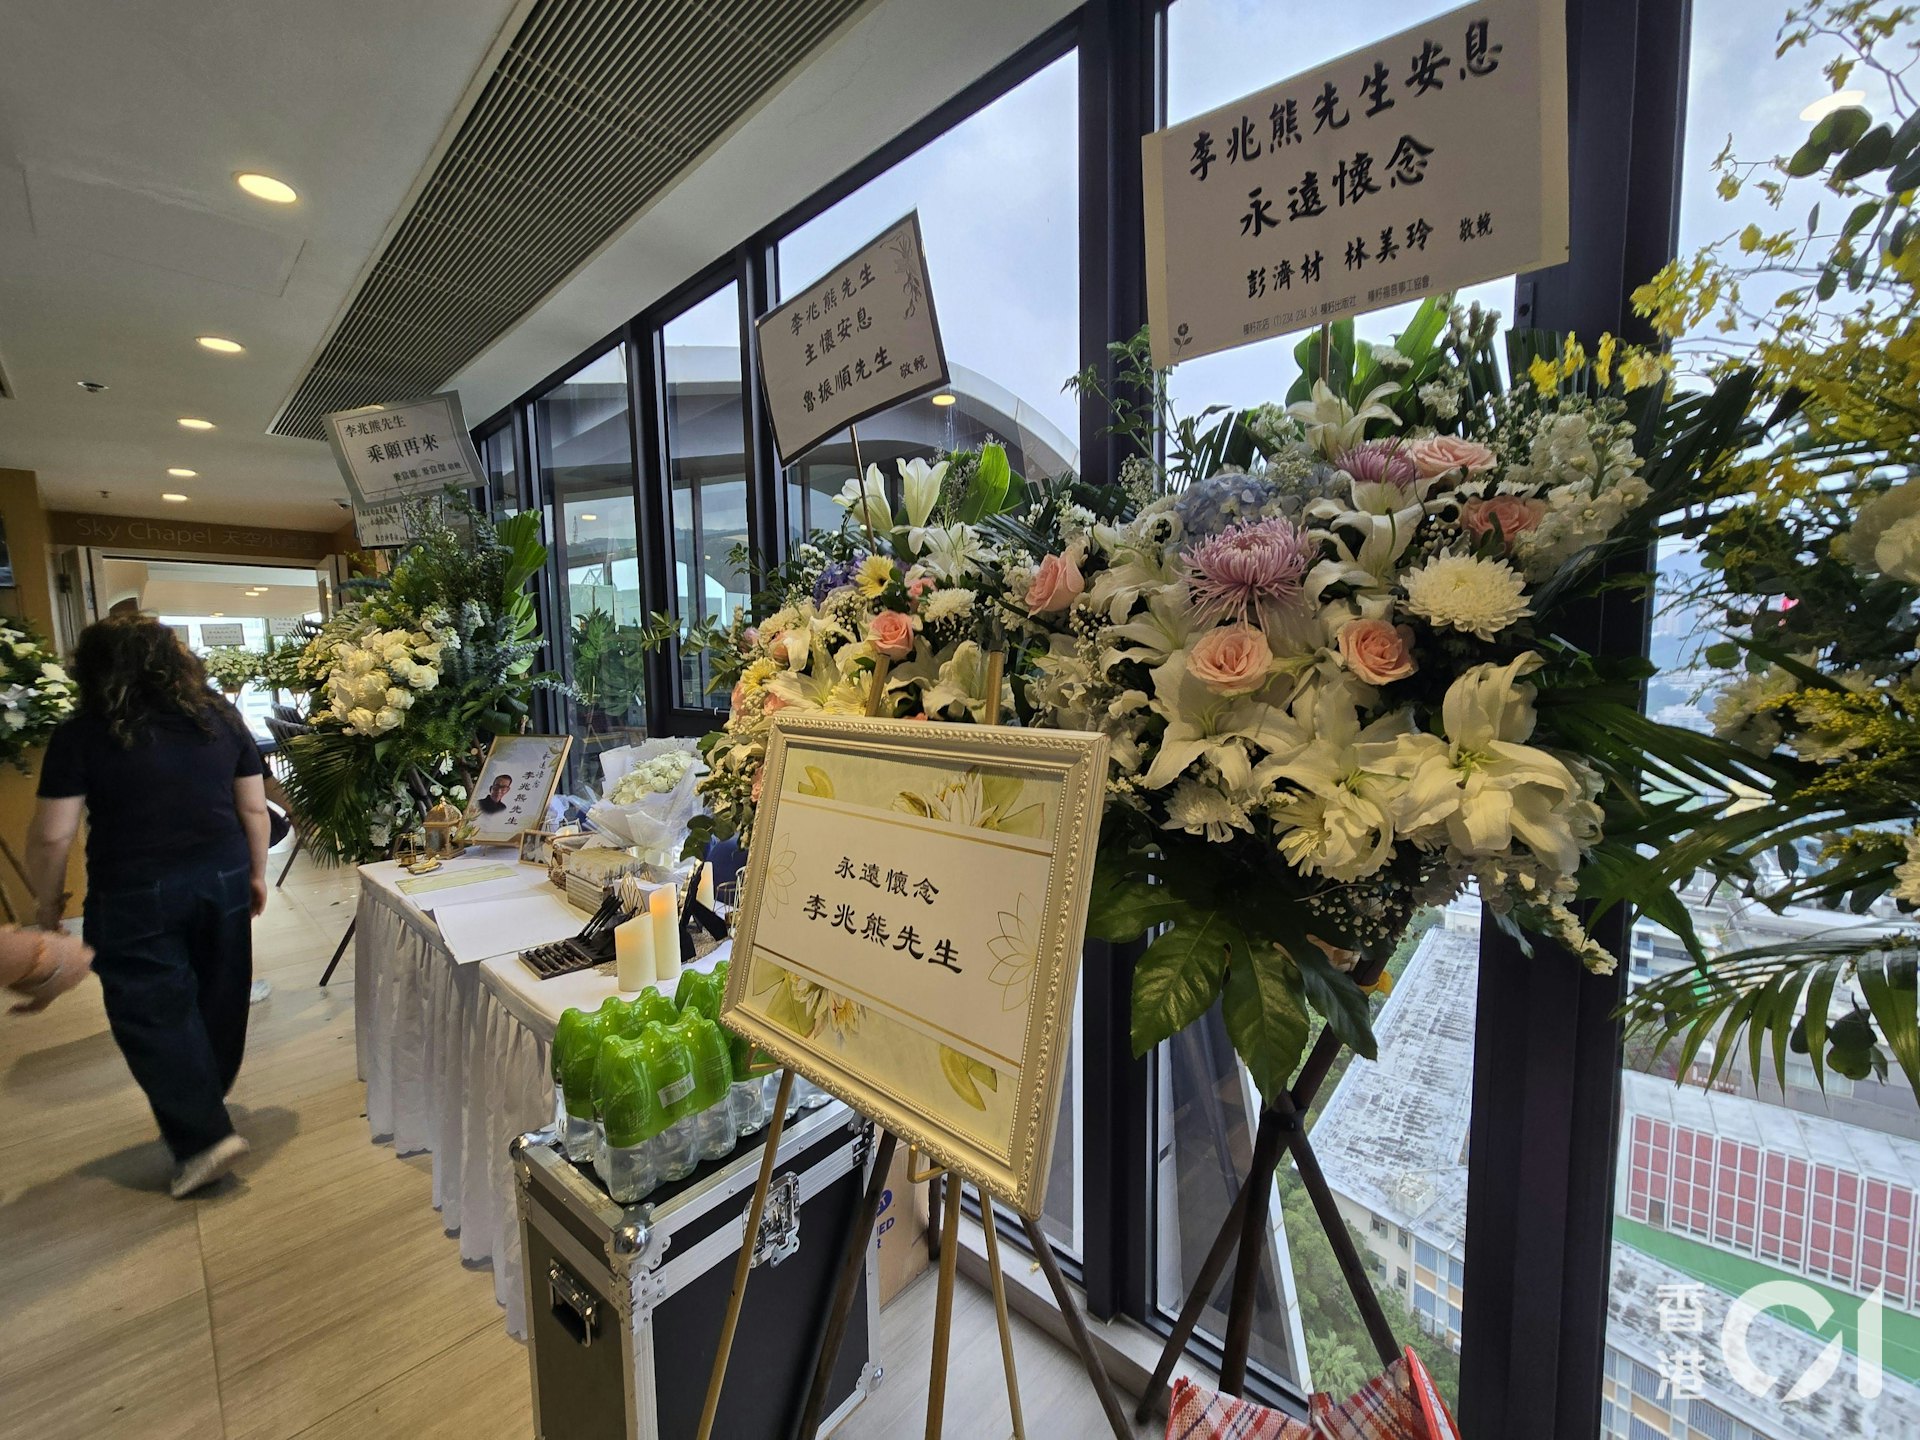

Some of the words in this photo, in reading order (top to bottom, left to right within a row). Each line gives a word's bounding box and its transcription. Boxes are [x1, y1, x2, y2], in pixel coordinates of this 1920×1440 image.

[1189, 18, 1503, 181] 李兆熊先生安息
[1240, 134, 1434, 237] 永遠懷念
[1247, 250, 1324, 298] 彭濟材
[1344, 217, 1434, 271] 林美玲
[1459, 211, 1493, 242] 敬輓
[790, 263, 876, 336] 李兆熊先生
[804, 306, 873, 367] 主懷安息
[803, 346, 893, 413] 魯振順先生
[899, 355, 929, 379] 敬輓
[344, 415, 407, 438] 李兆熊先生
[76, 518, 120, 541] Sky
[128, 523, 212, 546] Chapel
[834, 855, 940, 905] 永遠懷念
[802, 894, 963, 974] 李兆熊先生
